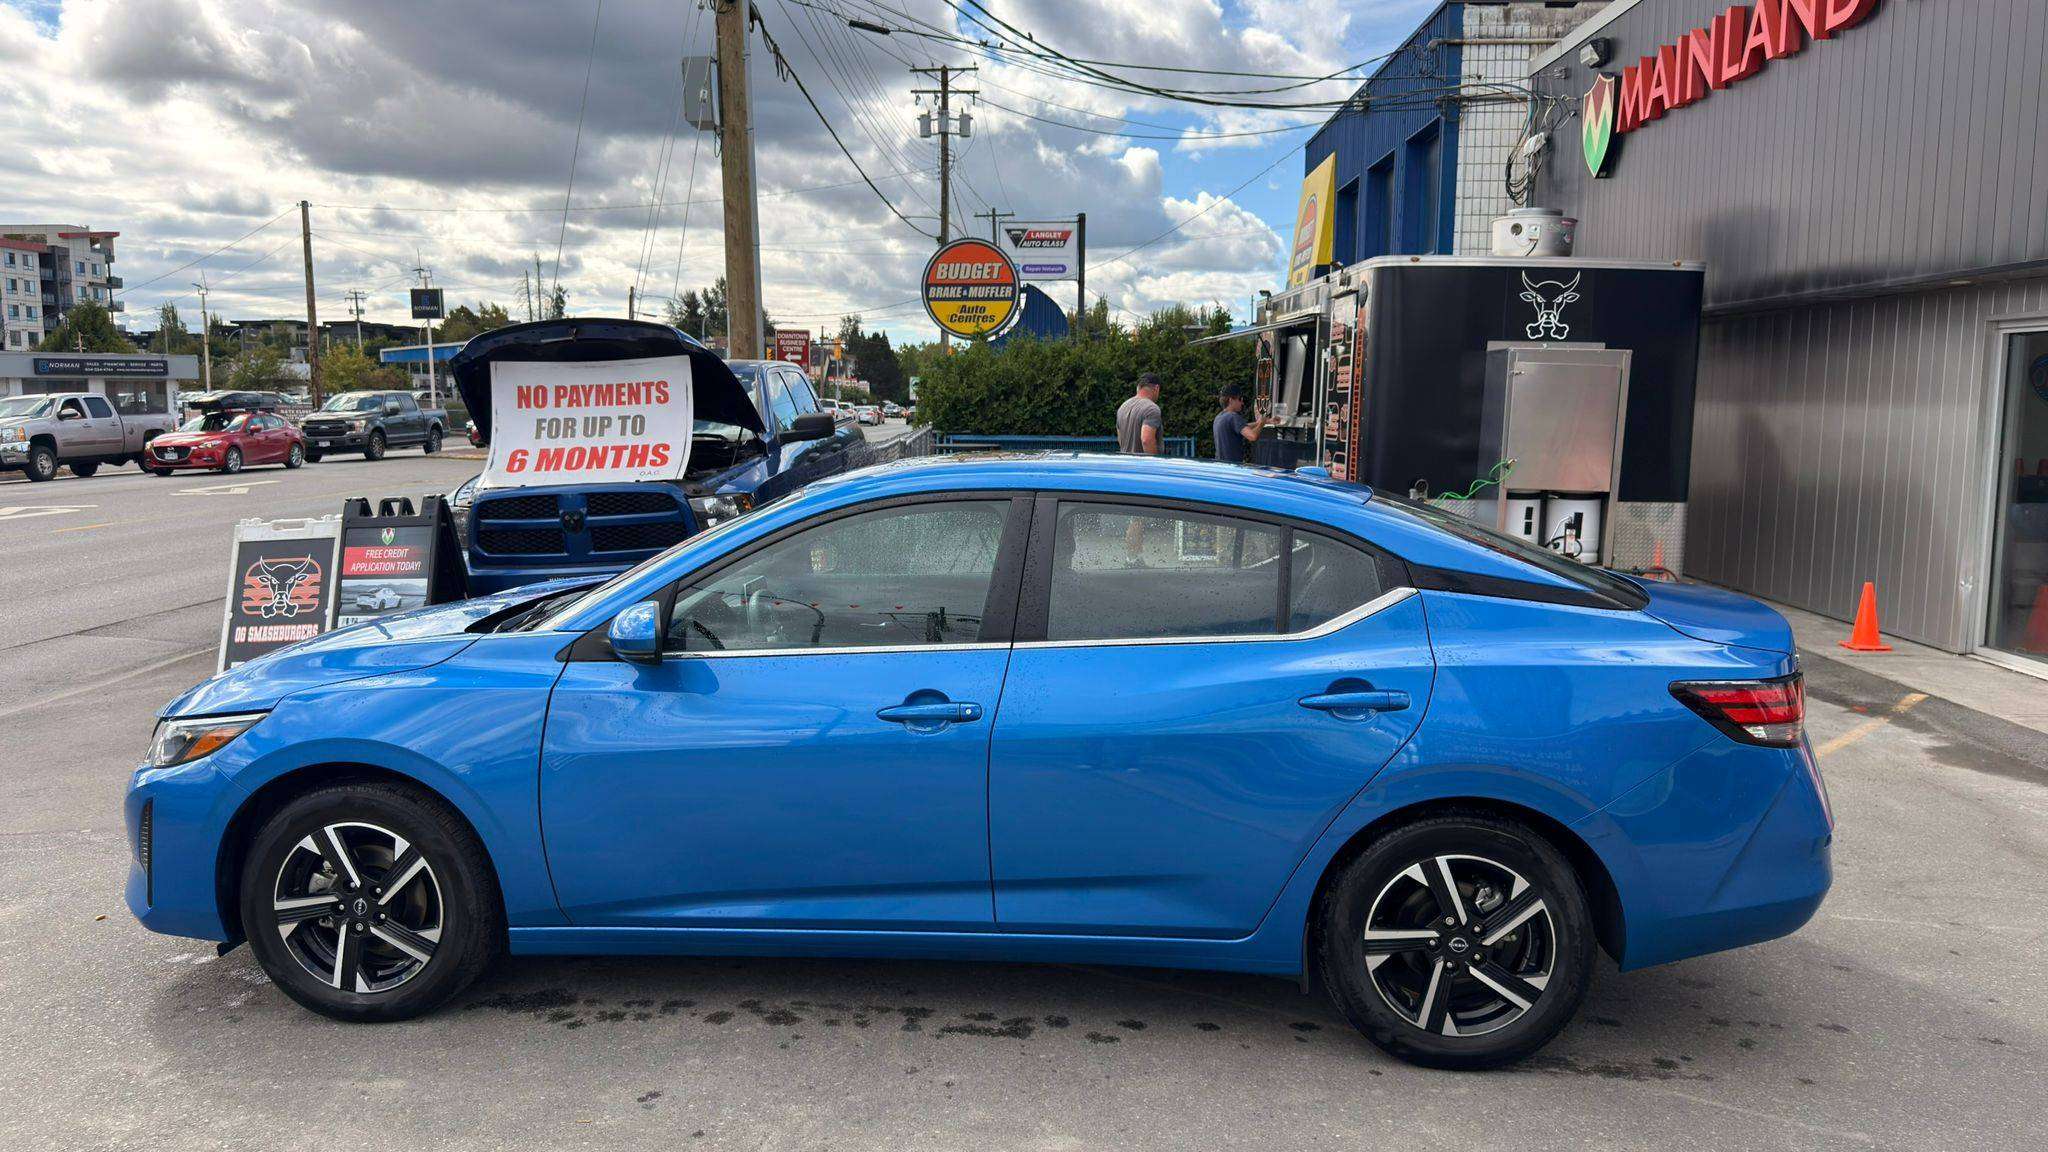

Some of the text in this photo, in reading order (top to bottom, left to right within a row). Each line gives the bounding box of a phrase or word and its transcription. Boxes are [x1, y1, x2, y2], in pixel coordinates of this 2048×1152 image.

[1031, 231, 1062, 239] LANGLEY
[936, 262, 1002, 280] BUDGET
[928, 286, 962, 298] BRAKE
[968, 286, 1012, 298] MUFFLER
[959, 304, 987, 314] Auto
[949, 313, 996, 323] Centres
[517, 380, 670, 409] NO PAYMENTS
[535, 414, 646, 440] FOR UP TO
[505, 443, 671, 473] 6 MONTHS
[365, 548, 409, 558] FREE CREDIT
[351, 562, 395, 571] APPLICATION
[234, 624, 319, 643] OG SMASHBURGERS
